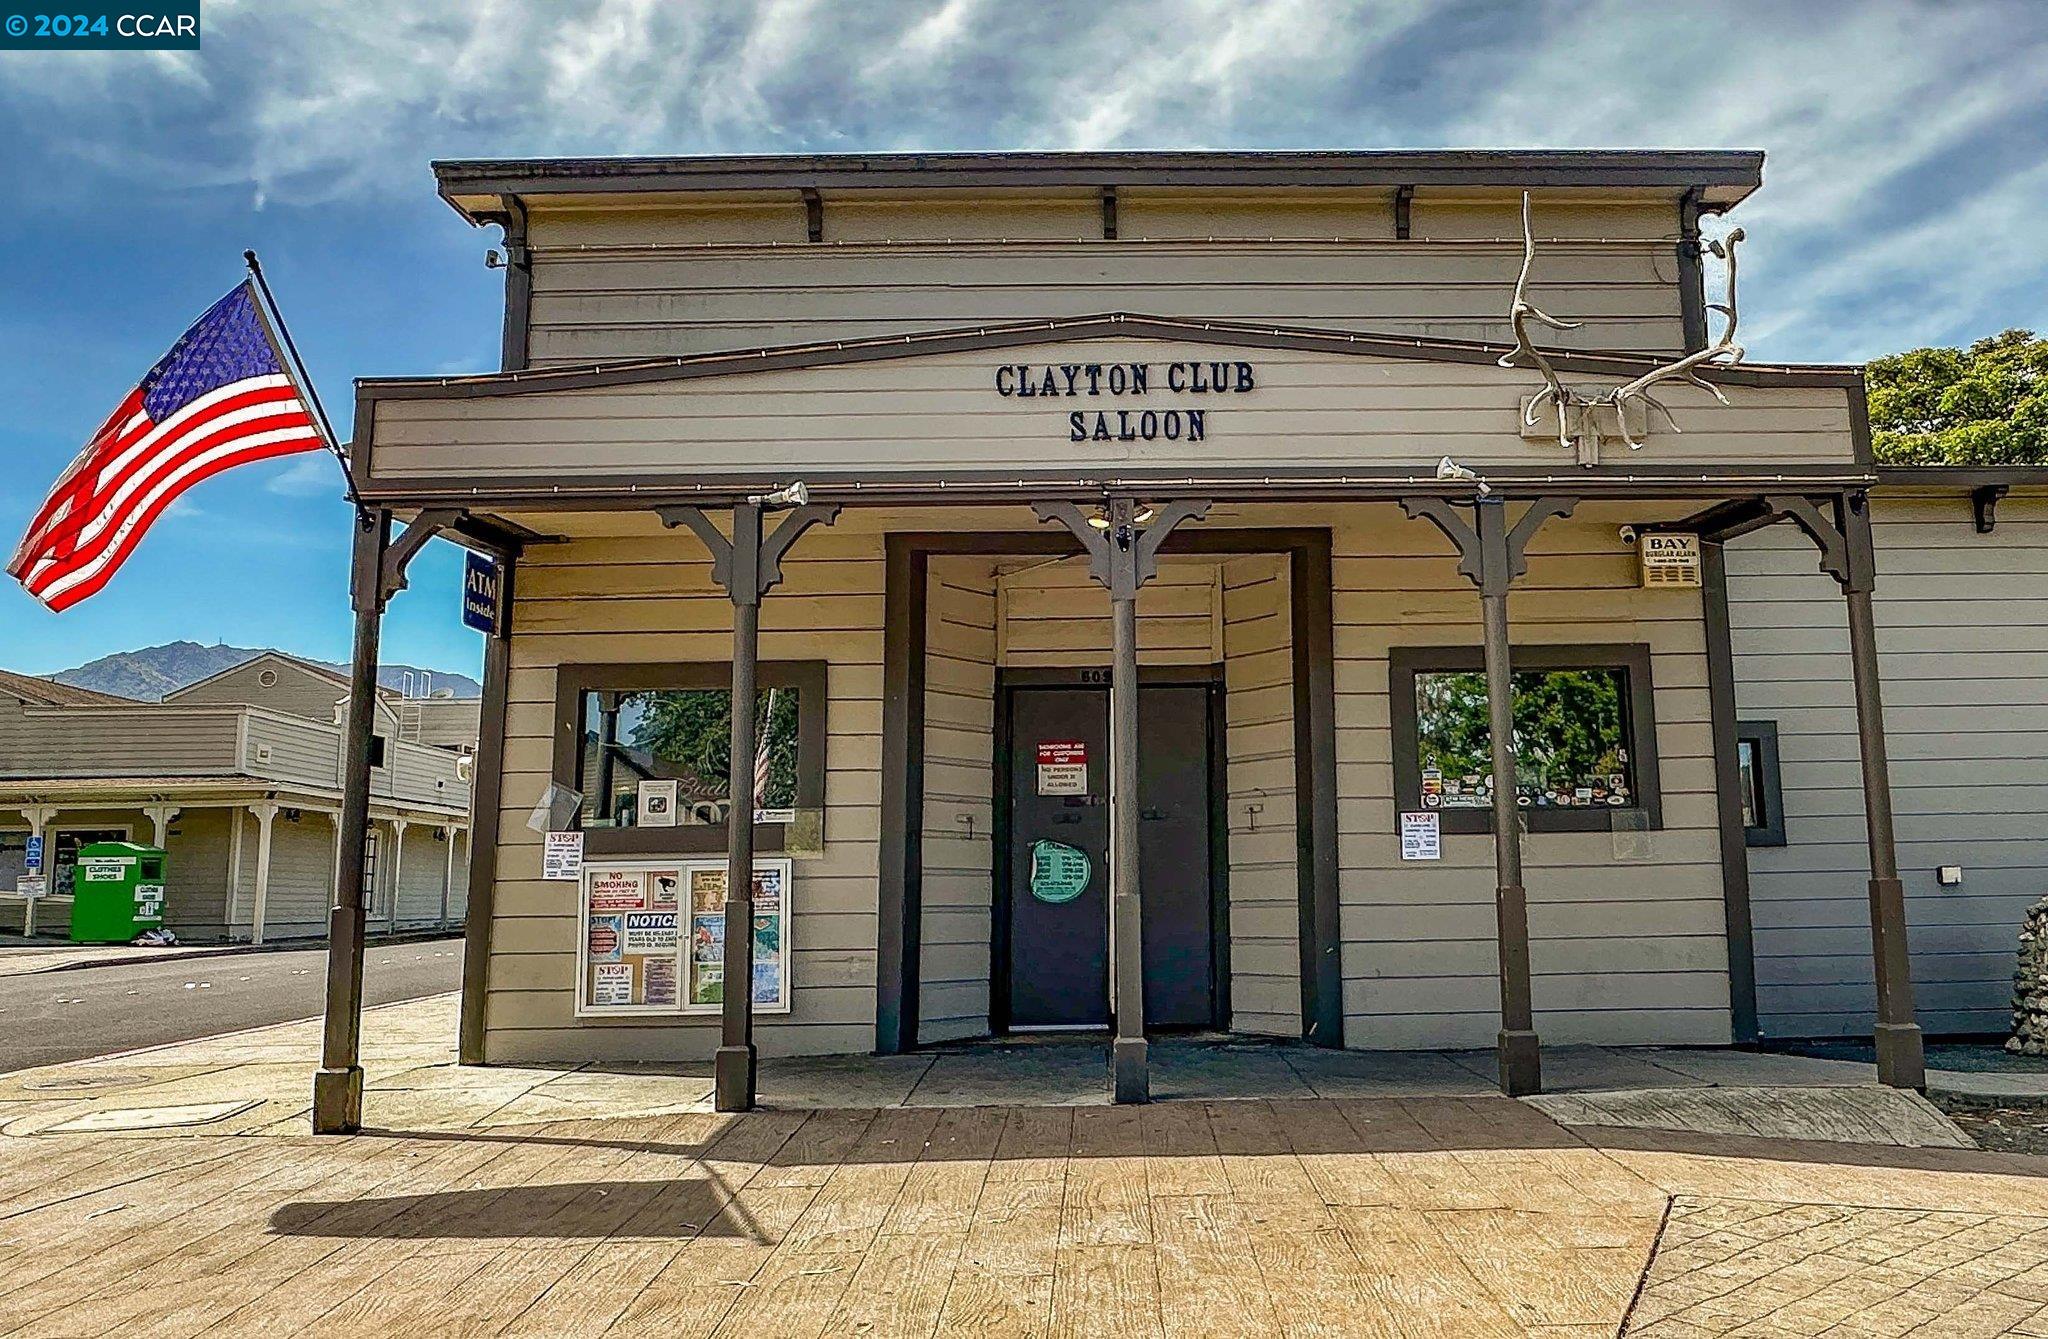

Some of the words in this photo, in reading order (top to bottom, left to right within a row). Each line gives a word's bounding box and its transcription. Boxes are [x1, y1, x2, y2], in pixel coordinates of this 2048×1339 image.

[996, 364, 1148, 397] CLAYTON
[1168, 362, 1254, 393] CLUB
[1070, 410, 1206, 441] SALOON
[1650, 538, 1691, 549] BAY
[467, 568, 496, 600] ATM
[466, 597, 495, 620] Inside
[1405, 814, 1434, 823] STOP
[550, 833, 579, 843] STOP
[609, 872, 623, 880] NO
[594, 881, 638, 889] SMOKING
[599, 966, 628, 975] STOP
